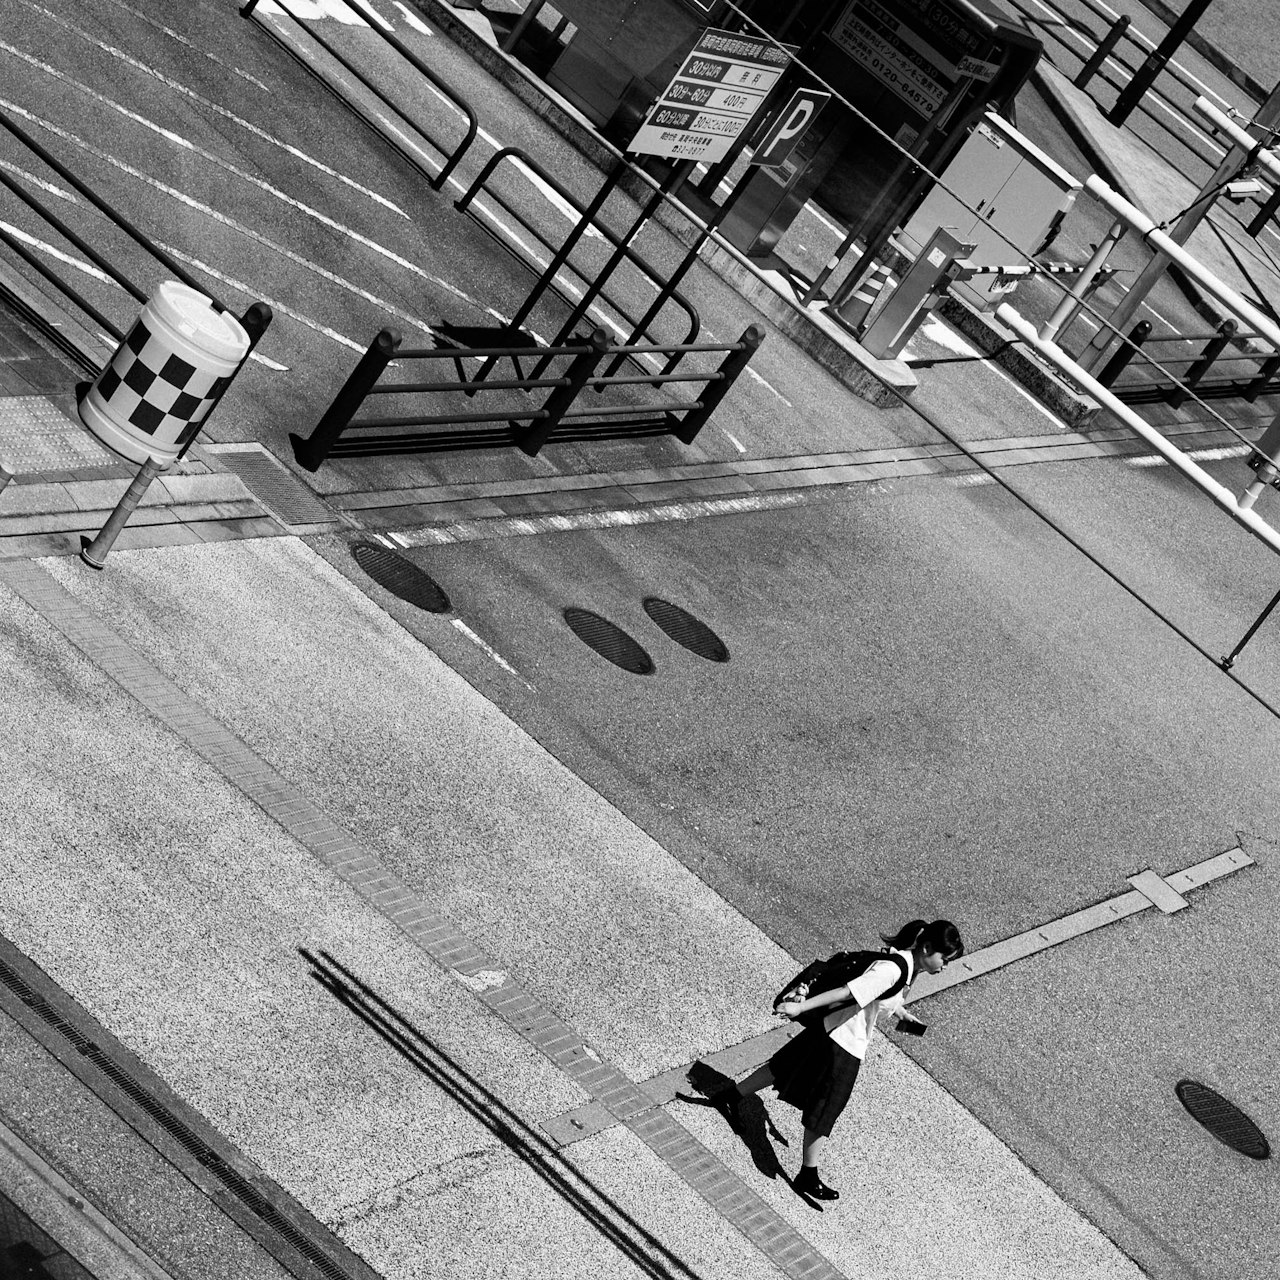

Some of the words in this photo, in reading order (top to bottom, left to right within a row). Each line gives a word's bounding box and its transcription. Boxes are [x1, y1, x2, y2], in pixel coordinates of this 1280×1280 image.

[689, 61, 722, 78] 30分以内
[723, 95, 747, 108] 400円
[656, 110, 690, 125] 60分以降
[693, 116, 742, 134] 30分ごとに100円
[762, 99, 815, 158] P
